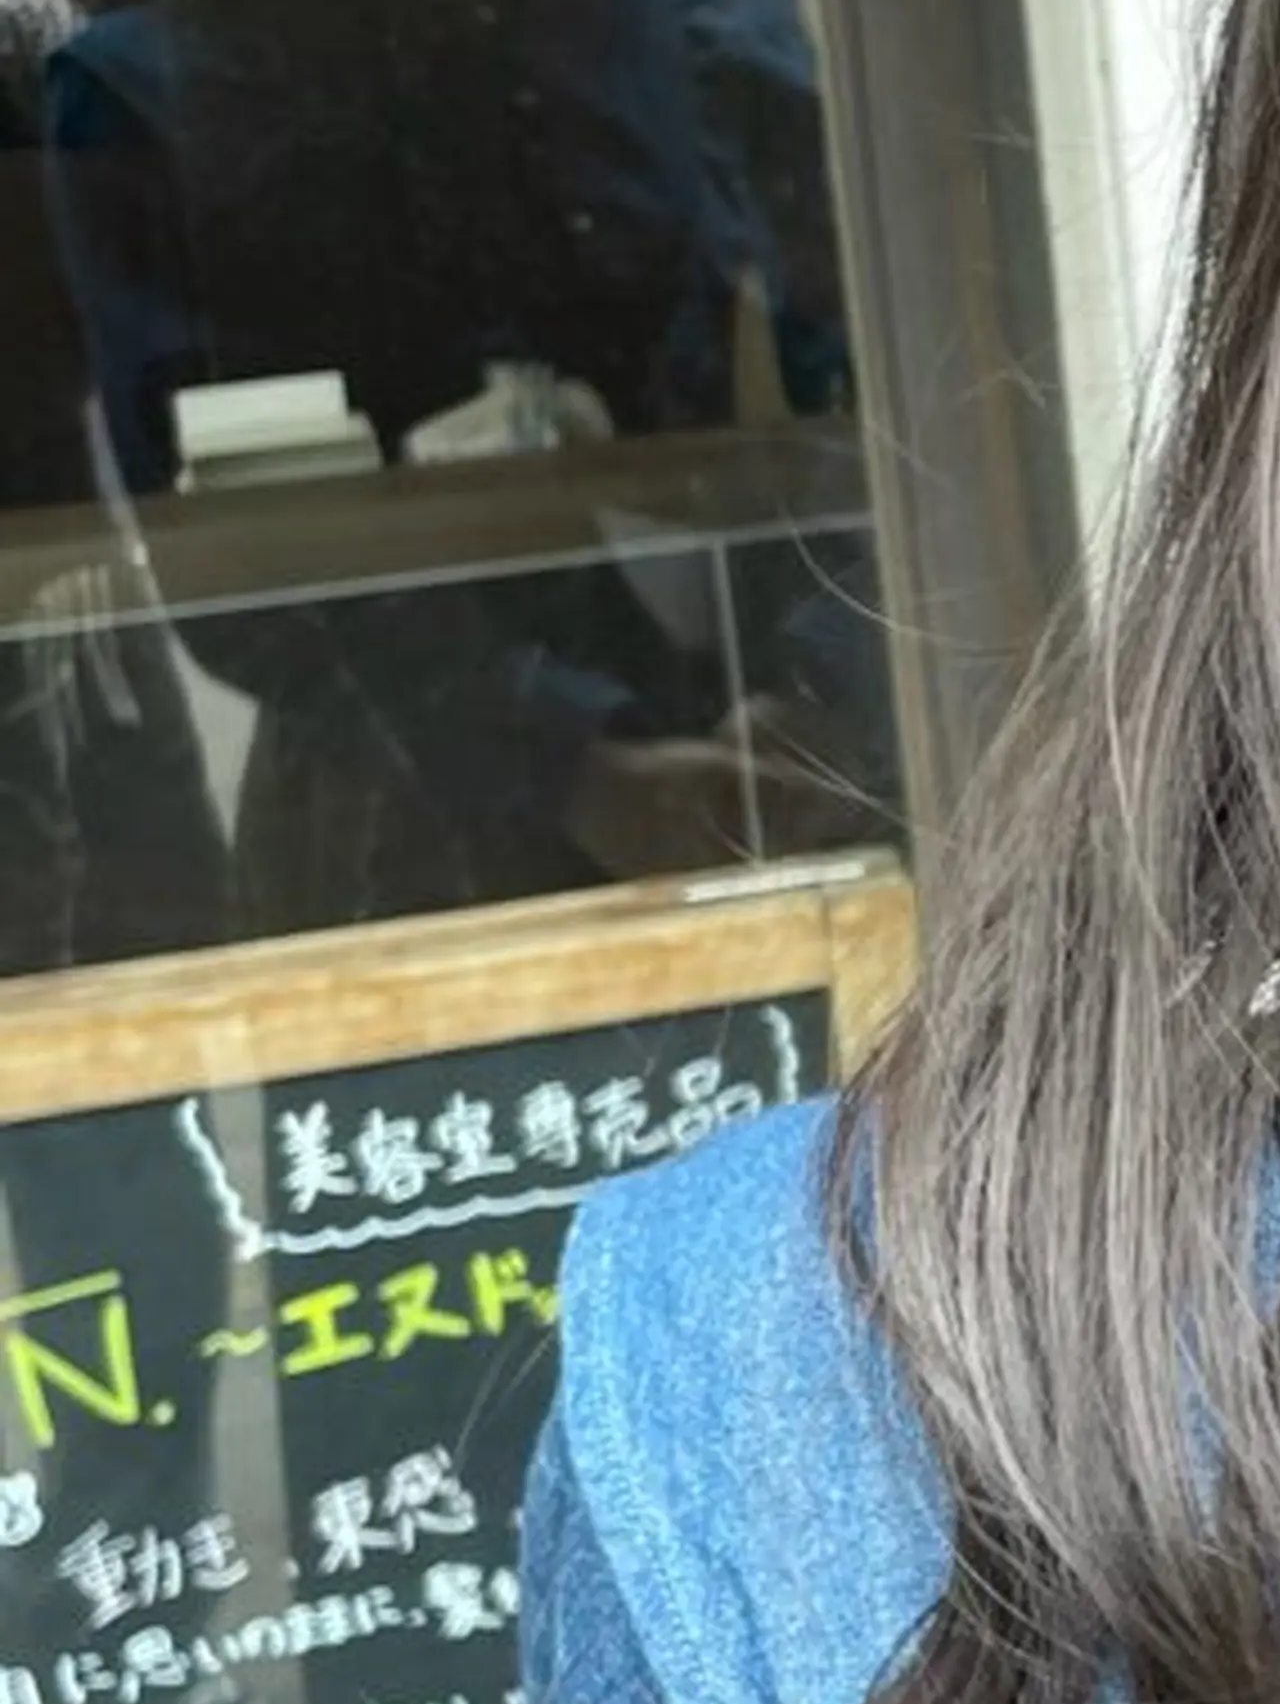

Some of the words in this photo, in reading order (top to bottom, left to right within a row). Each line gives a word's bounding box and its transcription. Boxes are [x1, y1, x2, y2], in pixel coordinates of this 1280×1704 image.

[275, 1055, 763, 1213] 美容室専売品
